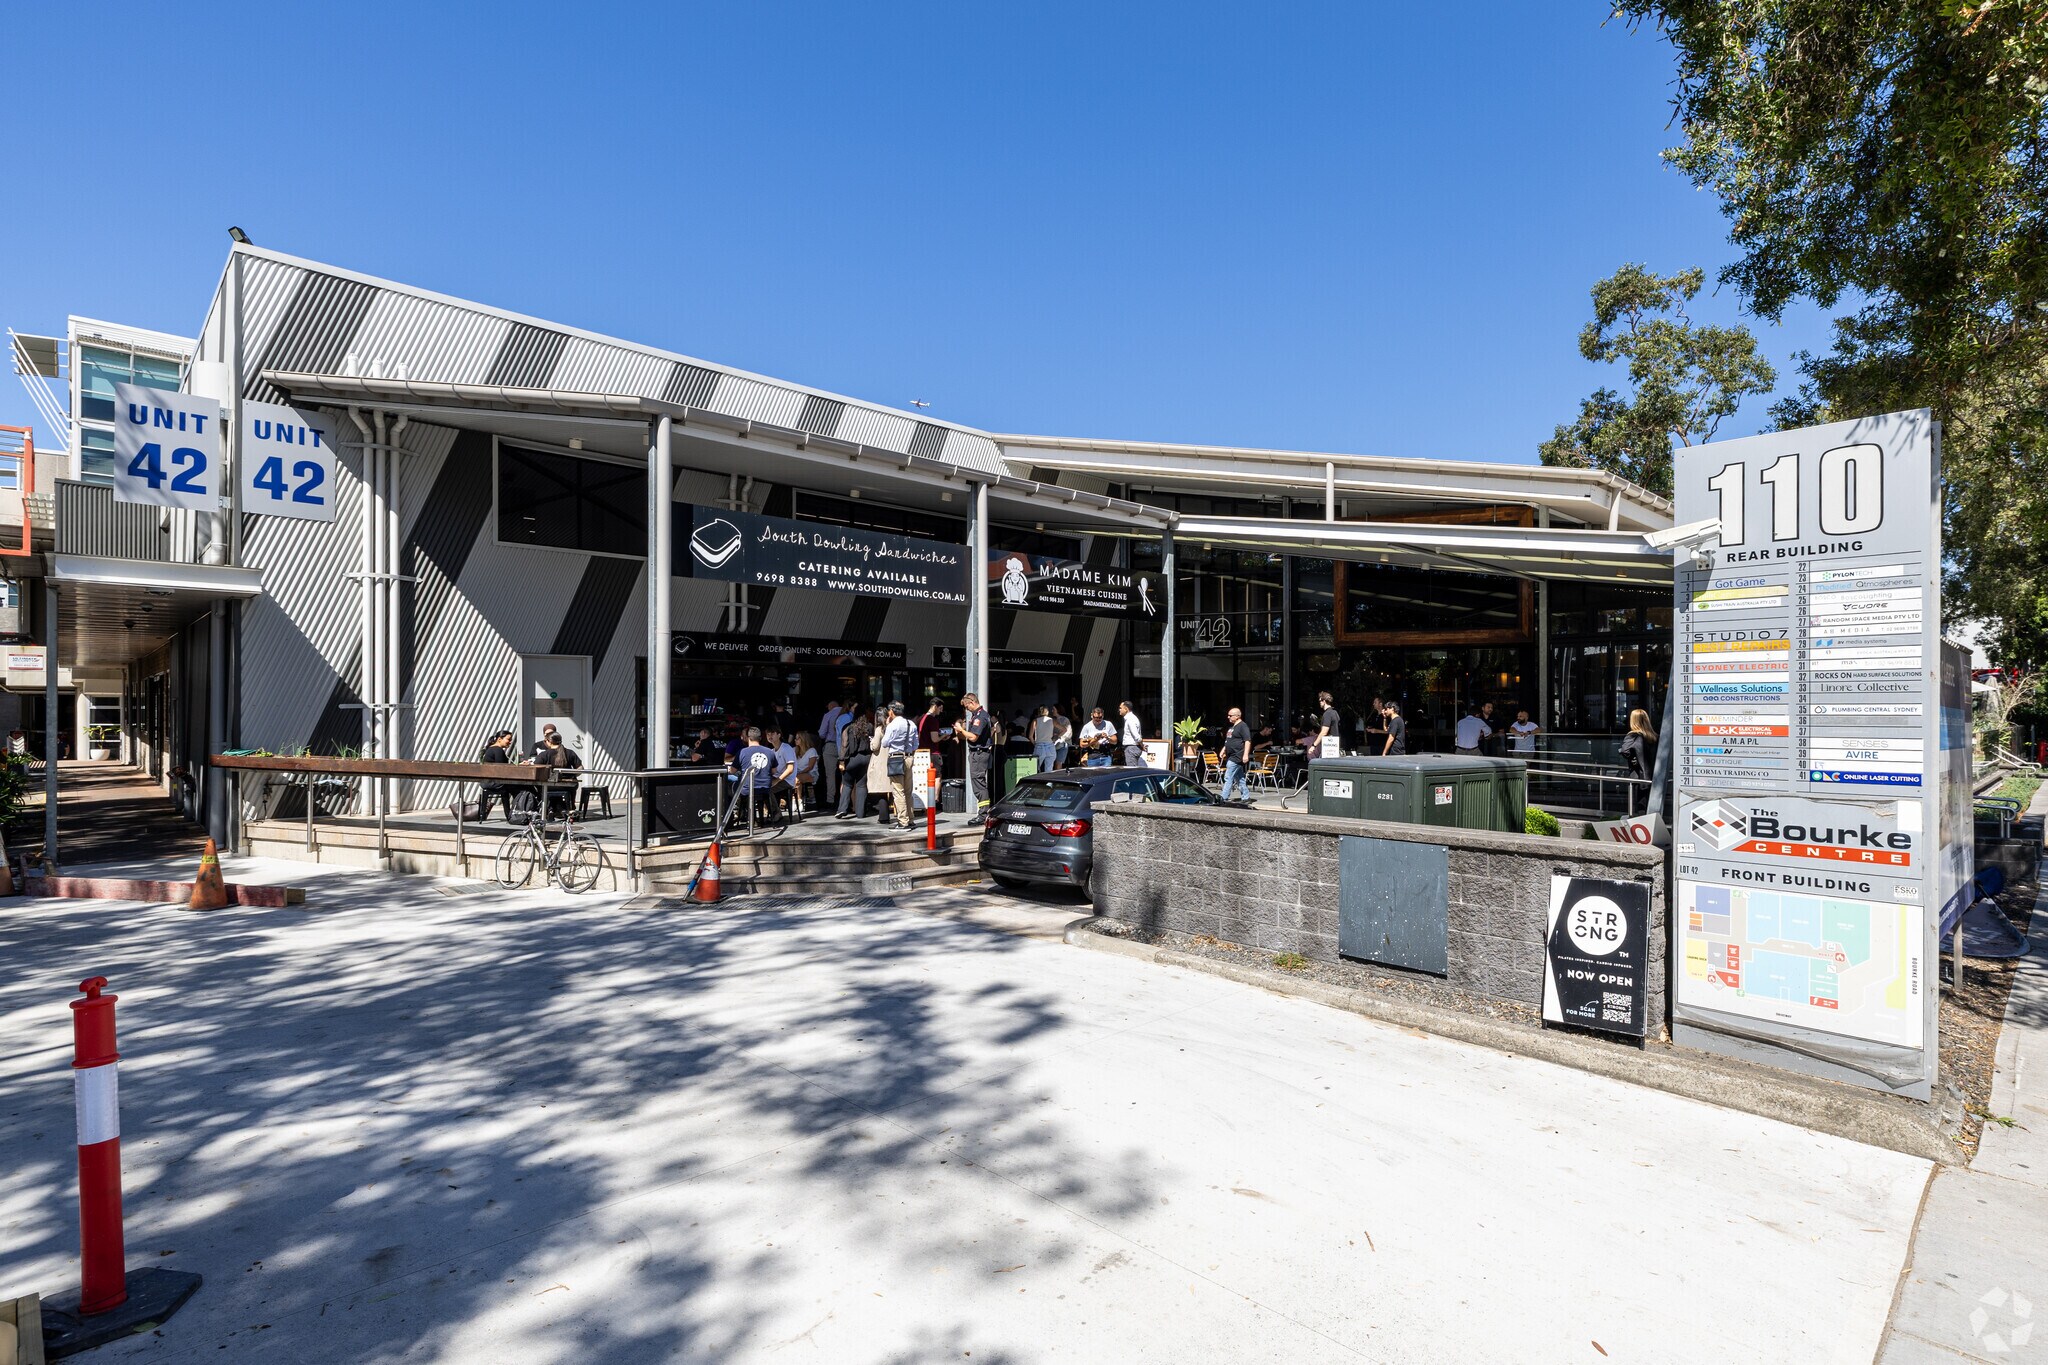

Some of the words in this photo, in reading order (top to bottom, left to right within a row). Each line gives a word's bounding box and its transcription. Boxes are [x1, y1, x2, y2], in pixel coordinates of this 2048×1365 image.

[129, 403, 208, 434] UNIT
[254, 420, 324, 448] UNIT
[127, 442, 207, 495] 42
[253, 456, 324, 505] 42
[1708, 442, 1884, 547] 110
[757, 525, 808, 545] South
[813, 533, 871, 561] Dowling
[874, 541, 957, 564] Sandwiches
[1727, 549, 1770, 563] REAR
[1776, 540, 1864, 559] BUILDING
[1798, 563, 1806, 571] 22
[799, 562, 861, 577] CATERING
[867, 569, 927, 584] AVAILABLE
[1039, 565, 1101, 584] MADAME
[1108, 574, 1131, 588] KIM
[1798, 574, 1806, 582] 23
[756, 572, 785, 583] 9698
[790, 576, 817, 587] 8388
[828, 580, 965, 602] WWW.SOUTHDOWLING.COM.AU
[1715, 580, 1732, 588] Got
[1736, 578, 1766, 586] Game
[1047, 584, 1096, 597] VIETNAMESE
[1098, 591, 1127, 600] CUISINE
[1798, 585, 1806, 593] 24
[1798, 596, 1806, 604] 25
[1083, 600, 1127, 610] MADAMEKIM.COM.AU
[1798, 607, 1806, 615] 26
[1180, 621, 1200, 629] UNIT
[1798, 618, 1806, 626] 27
[1195, 618, 1231, 648] 42
[1694, 630, 1771, 642] STUDIO
[1779, 630, 1788, 639] 7
[1798, 629, 1806, 637] 28
[1686, 634, 1690, 642] 7
[704, 642, 717, 650] WE
[719, 643, 748, 651] DELIVER
[1731, 640, 1791, 651] REPAIRS
[1798, 640, 1806, 648] 29
[758, 644, 783, 653] ORDER
[784, 646, 811, 655] ONLINE
[816, 648, 901, 659] SOUTHDOWLING.COM.AU
[1798, 651, 1806, 659] 30
[1011, 657, 1065, 667] MADAMEKIM.COM.AU
[1798, 662, 1806, 670] 31
[1683, 685, 1689, 693] 12
[1700, 685, 1738, 693] Wellness
[1741, 684, 1782, 692] Solutions
[1857, 682, 1909, 691] Collective
[1798, 695, 1806, 703] 34
[1798, 706, 1806, 714] 35
[1709, 726, 1738, 735] D&K
[1842, 740, 1889, 748] SENSES
[1798, 749, 1806, 757] 39
[1846, 751, 1878, 759] AVIRE
[1798, 760, 1806, 769] 40
[1683, 767, 1690, 775] 20
[1723, 769, 1756, 777] TRADING
[1798, 772, 1806, 780] 41
[1684, 777, 1690, 785] 21
[1750, 808, 1778, 817] The
[1609, 823, 1651, 845] NO
[1750, 816, 1912, 850] Bourke
[1755, 842, 1902, 864] CENTRE
[1680, 865, 1691, 874] LOT
[1691, 866, 1698, 875] 42
[1722, 868, 1776, 883] FRONT
[1782, 874, 1871, 893] BUILDING
[1567, 969, 1595, 981] NOW
[1598, 973, 1633, 987] OPEN
[1579, 1010, 1596, 1018] MORE
